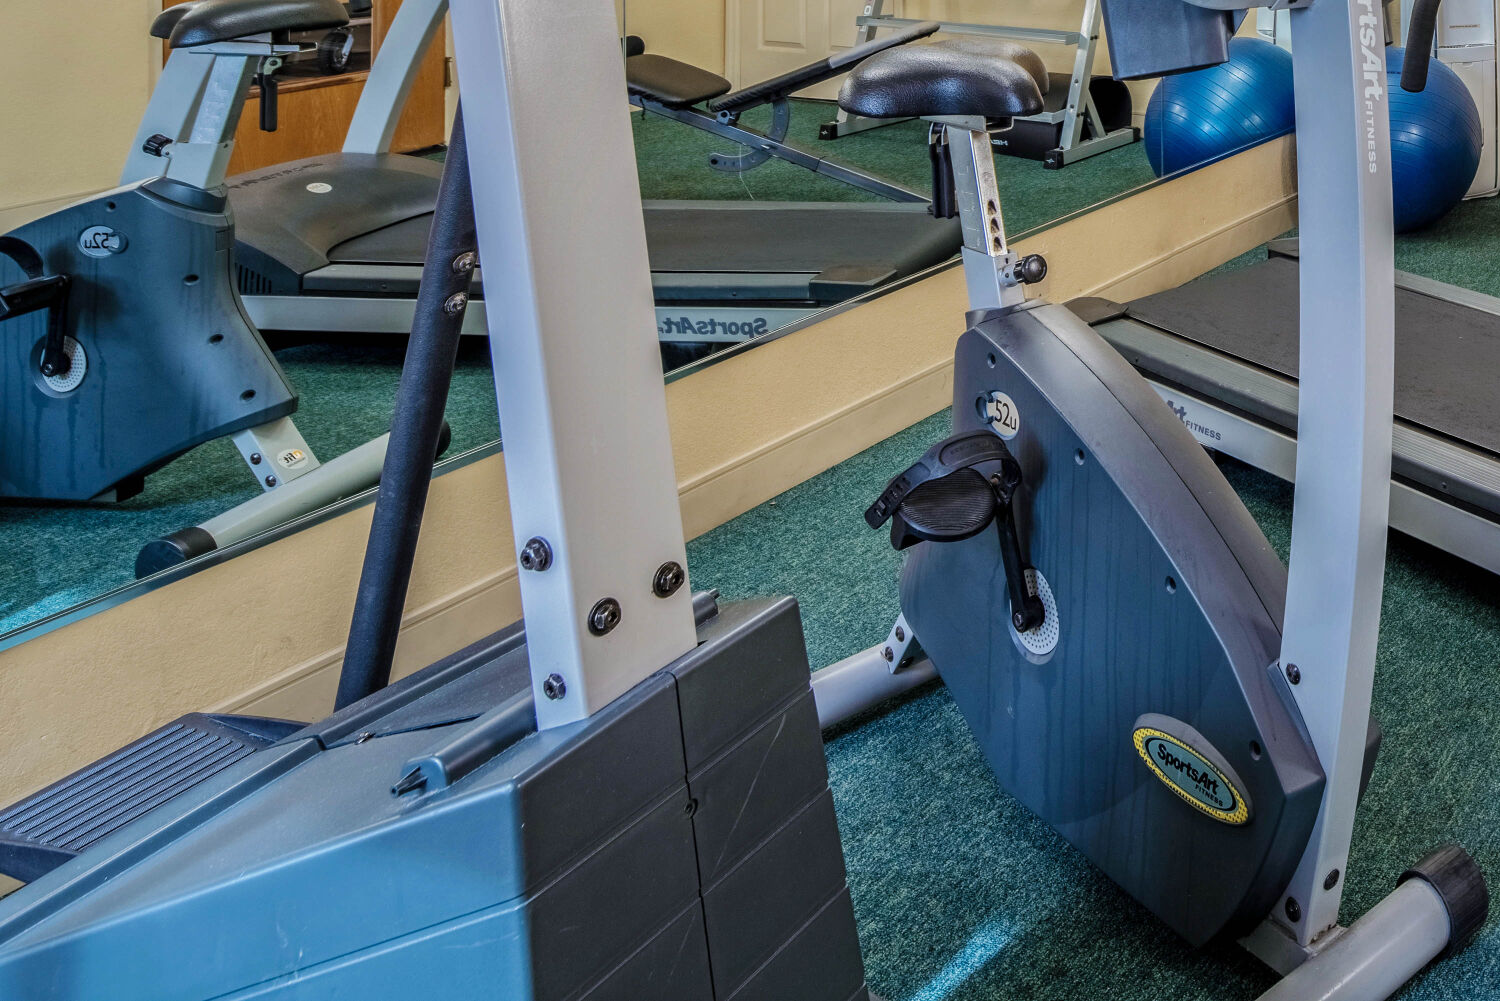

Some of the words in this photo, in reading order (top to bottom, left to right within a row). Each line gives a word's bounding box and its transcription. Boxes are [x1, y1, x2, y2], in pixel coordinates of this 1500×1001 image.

[1365, 101, 1377, 174] FITNESS
[994, 398, 1017, 431] 52u
[1185, 420, 1222, 441] FITNESS
[1157, 743, 1220, 795] SportsArt
[1194, 784, 1224, 807] FITNESS
